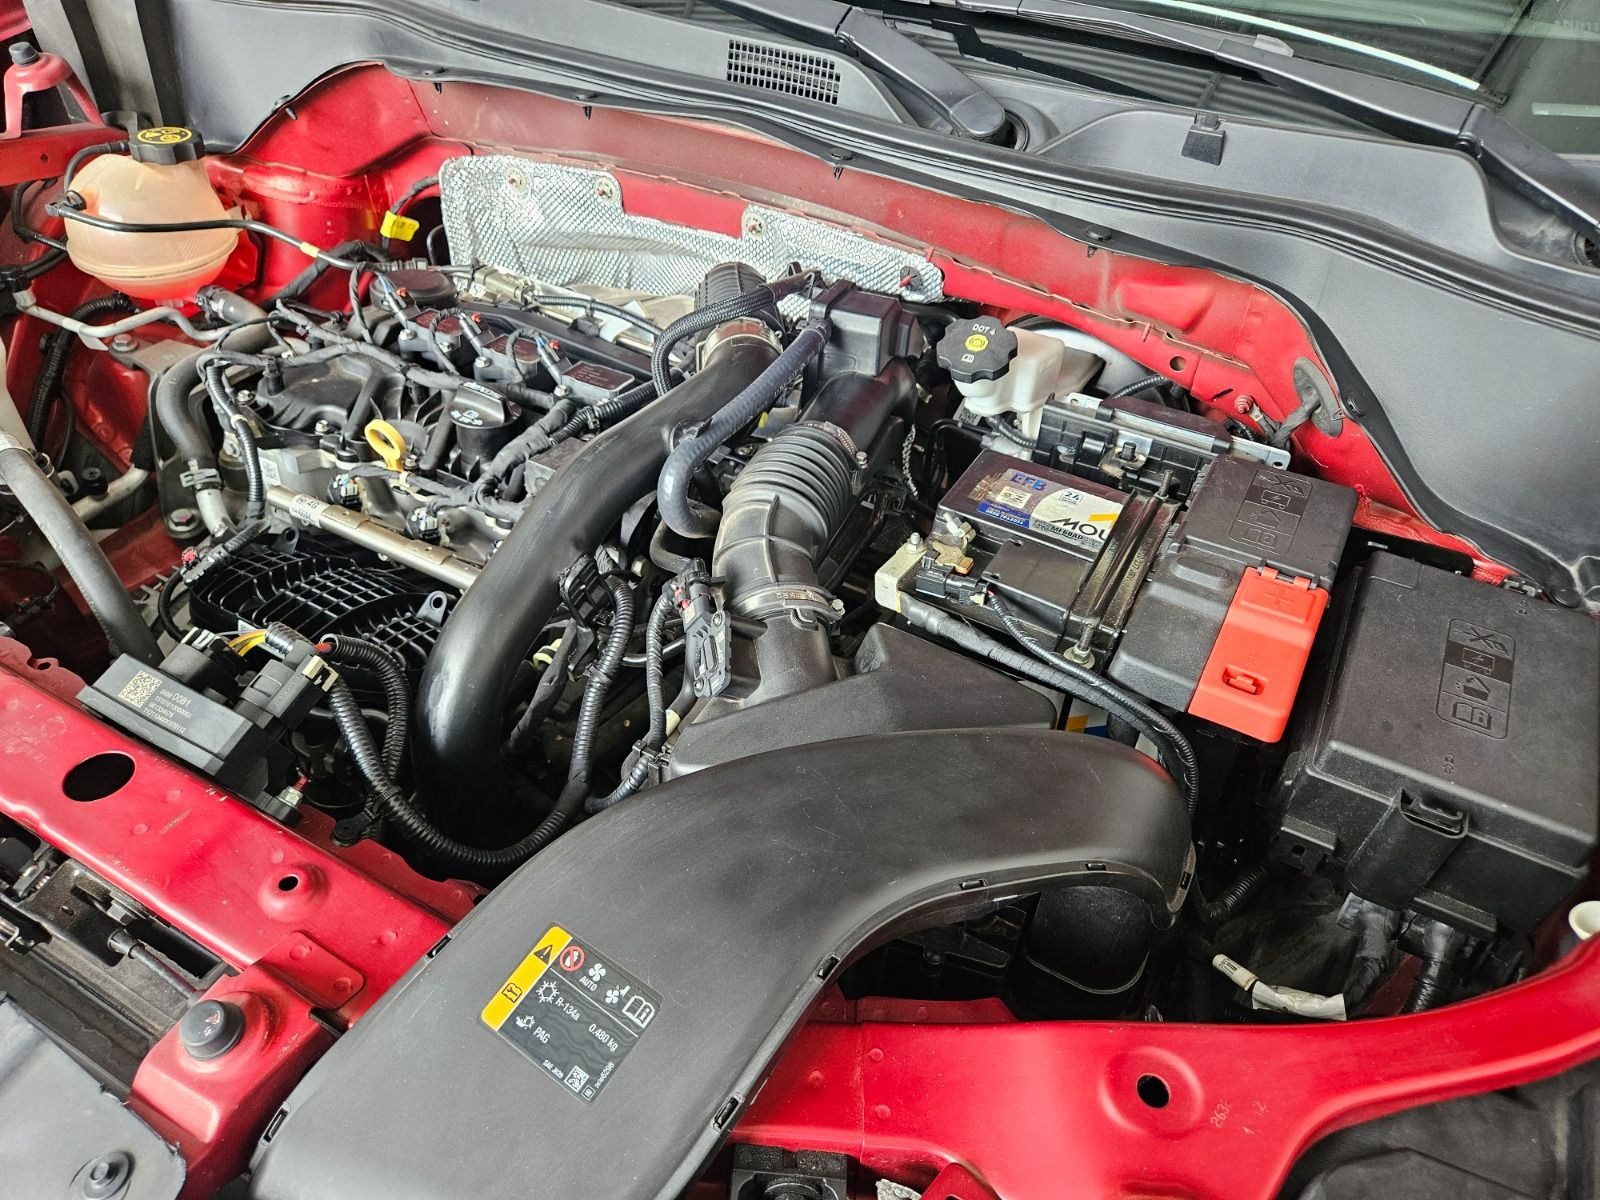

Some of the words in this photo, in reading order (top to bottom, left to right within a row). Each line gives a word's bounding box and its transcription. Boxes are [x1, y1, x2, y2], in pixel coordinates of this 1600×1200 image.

[972, 323, 990, 333] DOT
[990, 328, 997, 336] 4
[1010, 472, 1047, 491] EFB
[579, 975, 598, 992] AUTO
[555, 996, 580, 1021] R-134a
[588, 1023, 610, 1043] 0.480
[607, 1038, 619, 1053] kg
[533, 1026, 551, 1044] PAG
